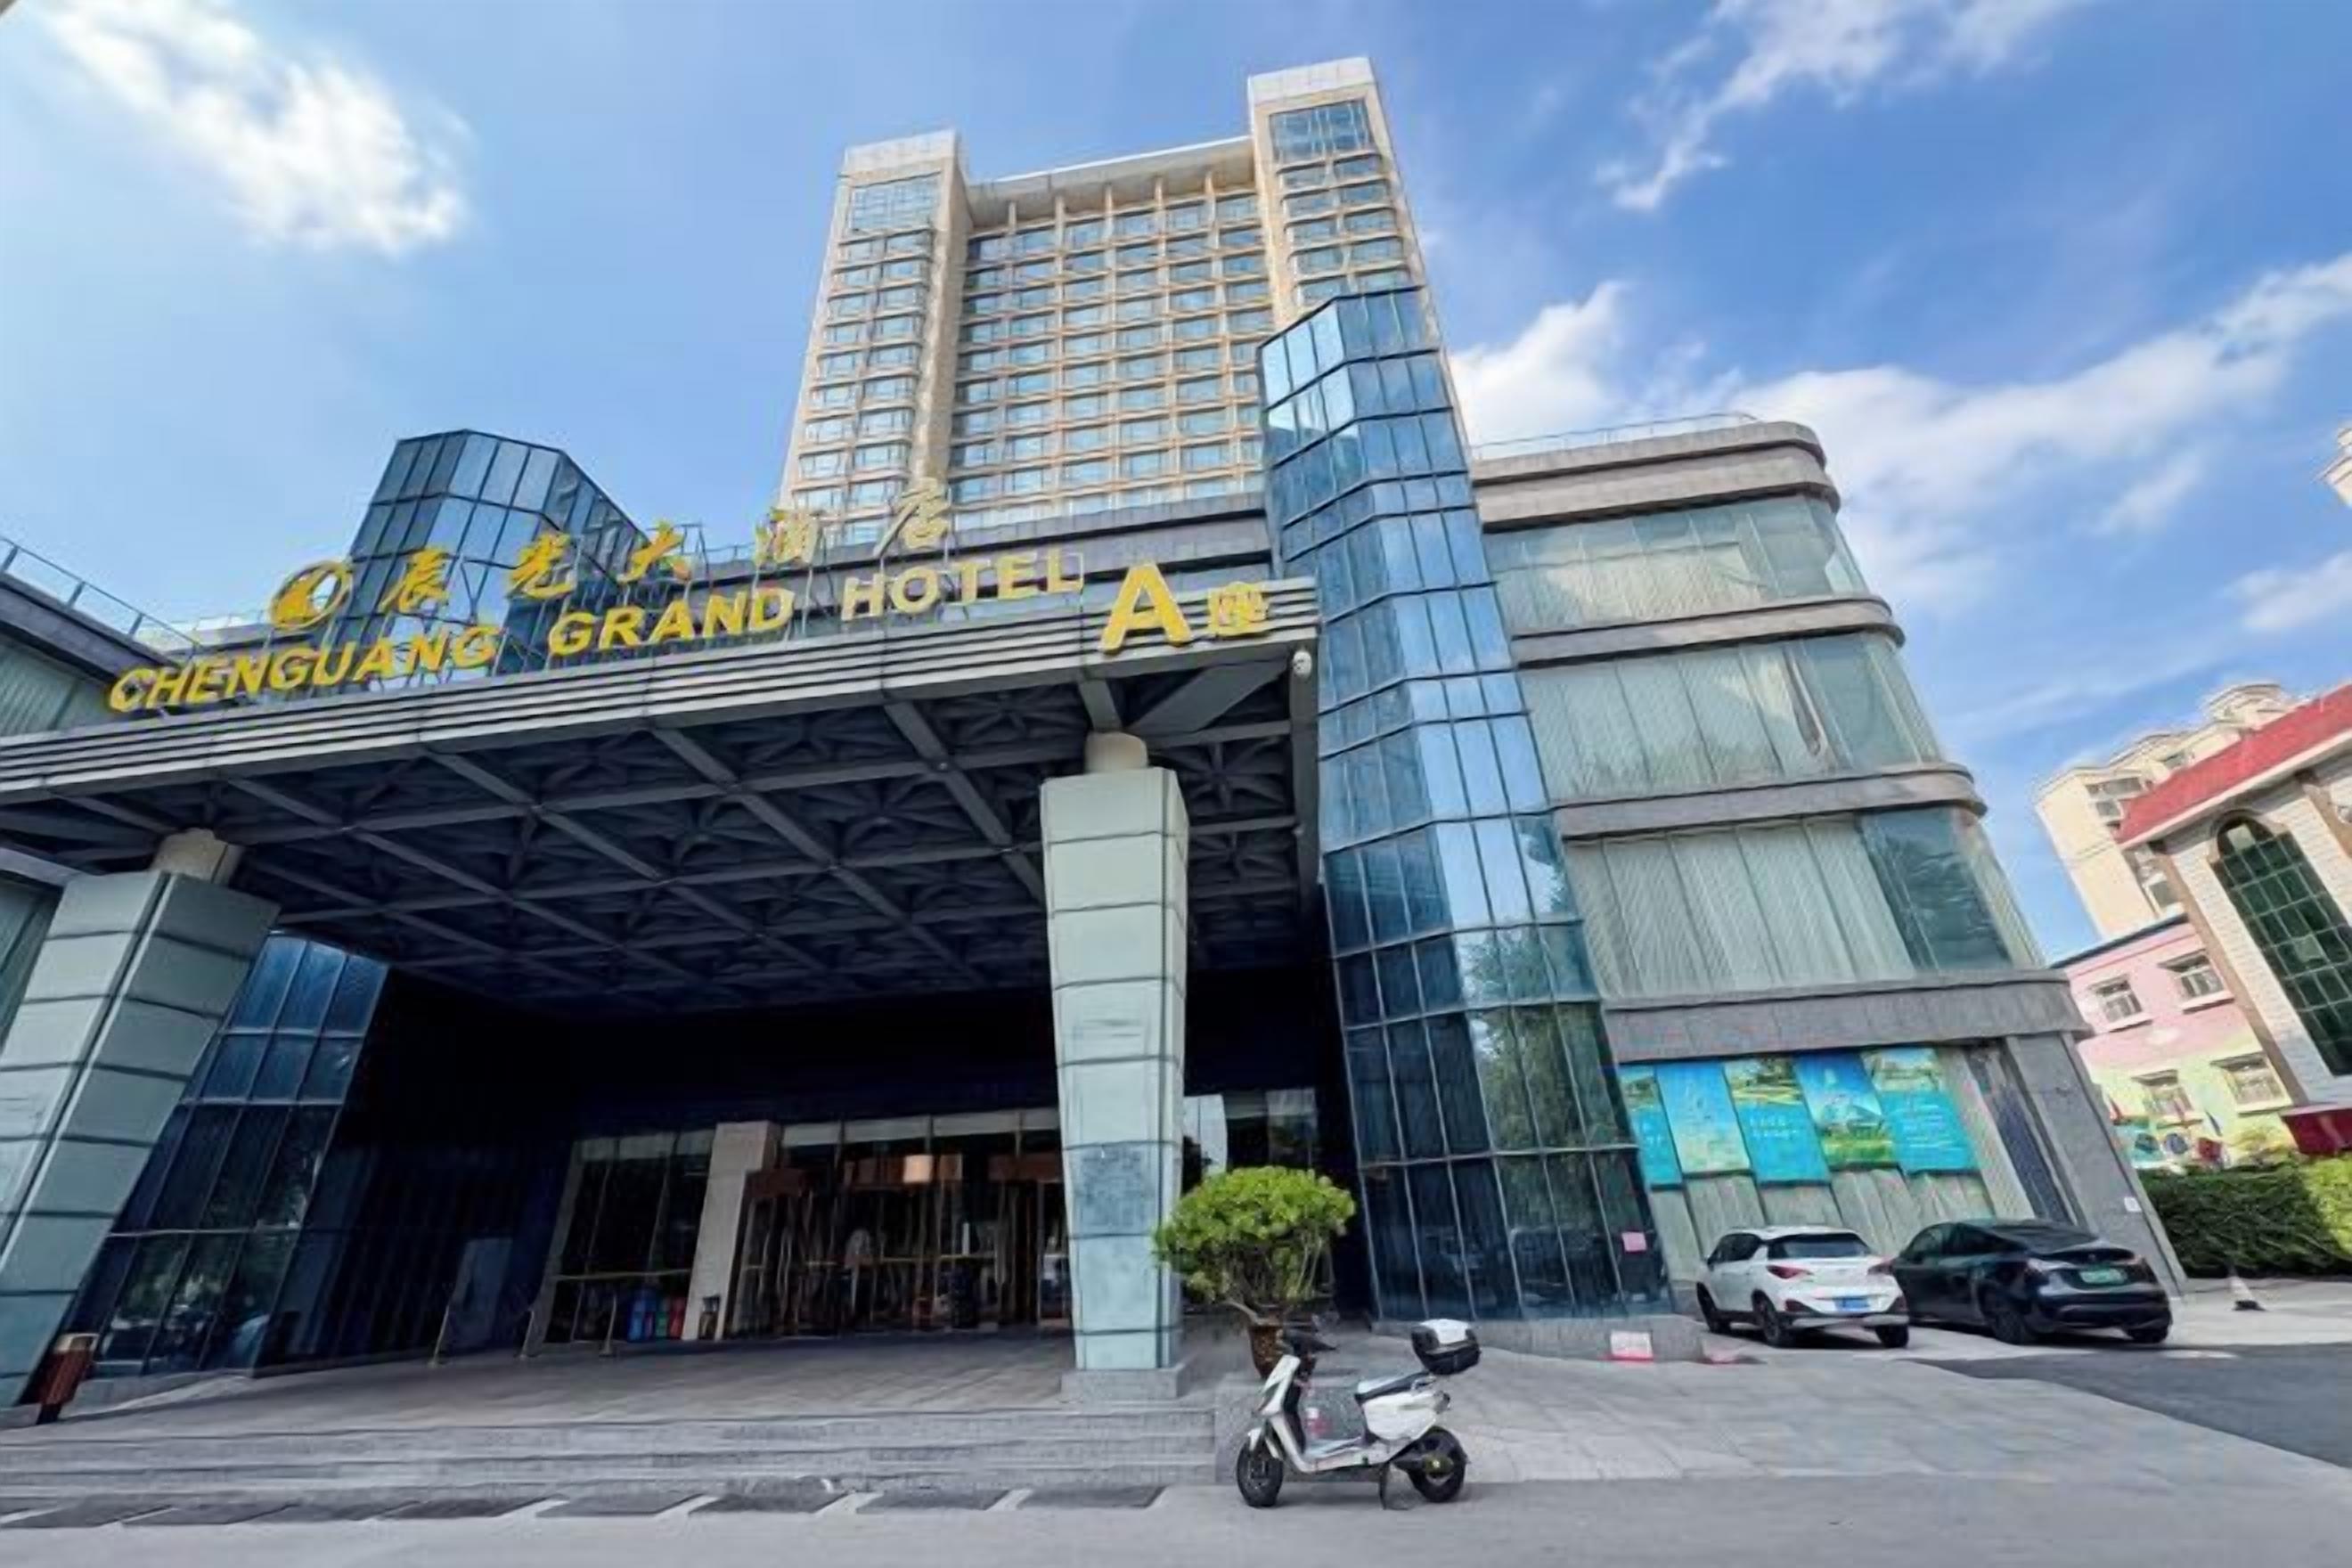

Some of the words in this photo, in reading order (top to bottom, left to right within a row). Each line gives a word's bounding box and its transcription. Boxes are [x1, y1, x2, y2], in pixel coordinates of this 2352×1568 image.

[109, 625, 504, 712] CHENGUANG
[549, 586, 795, 656] GRAND
[841, 547, 1083, 620] HOTEL
